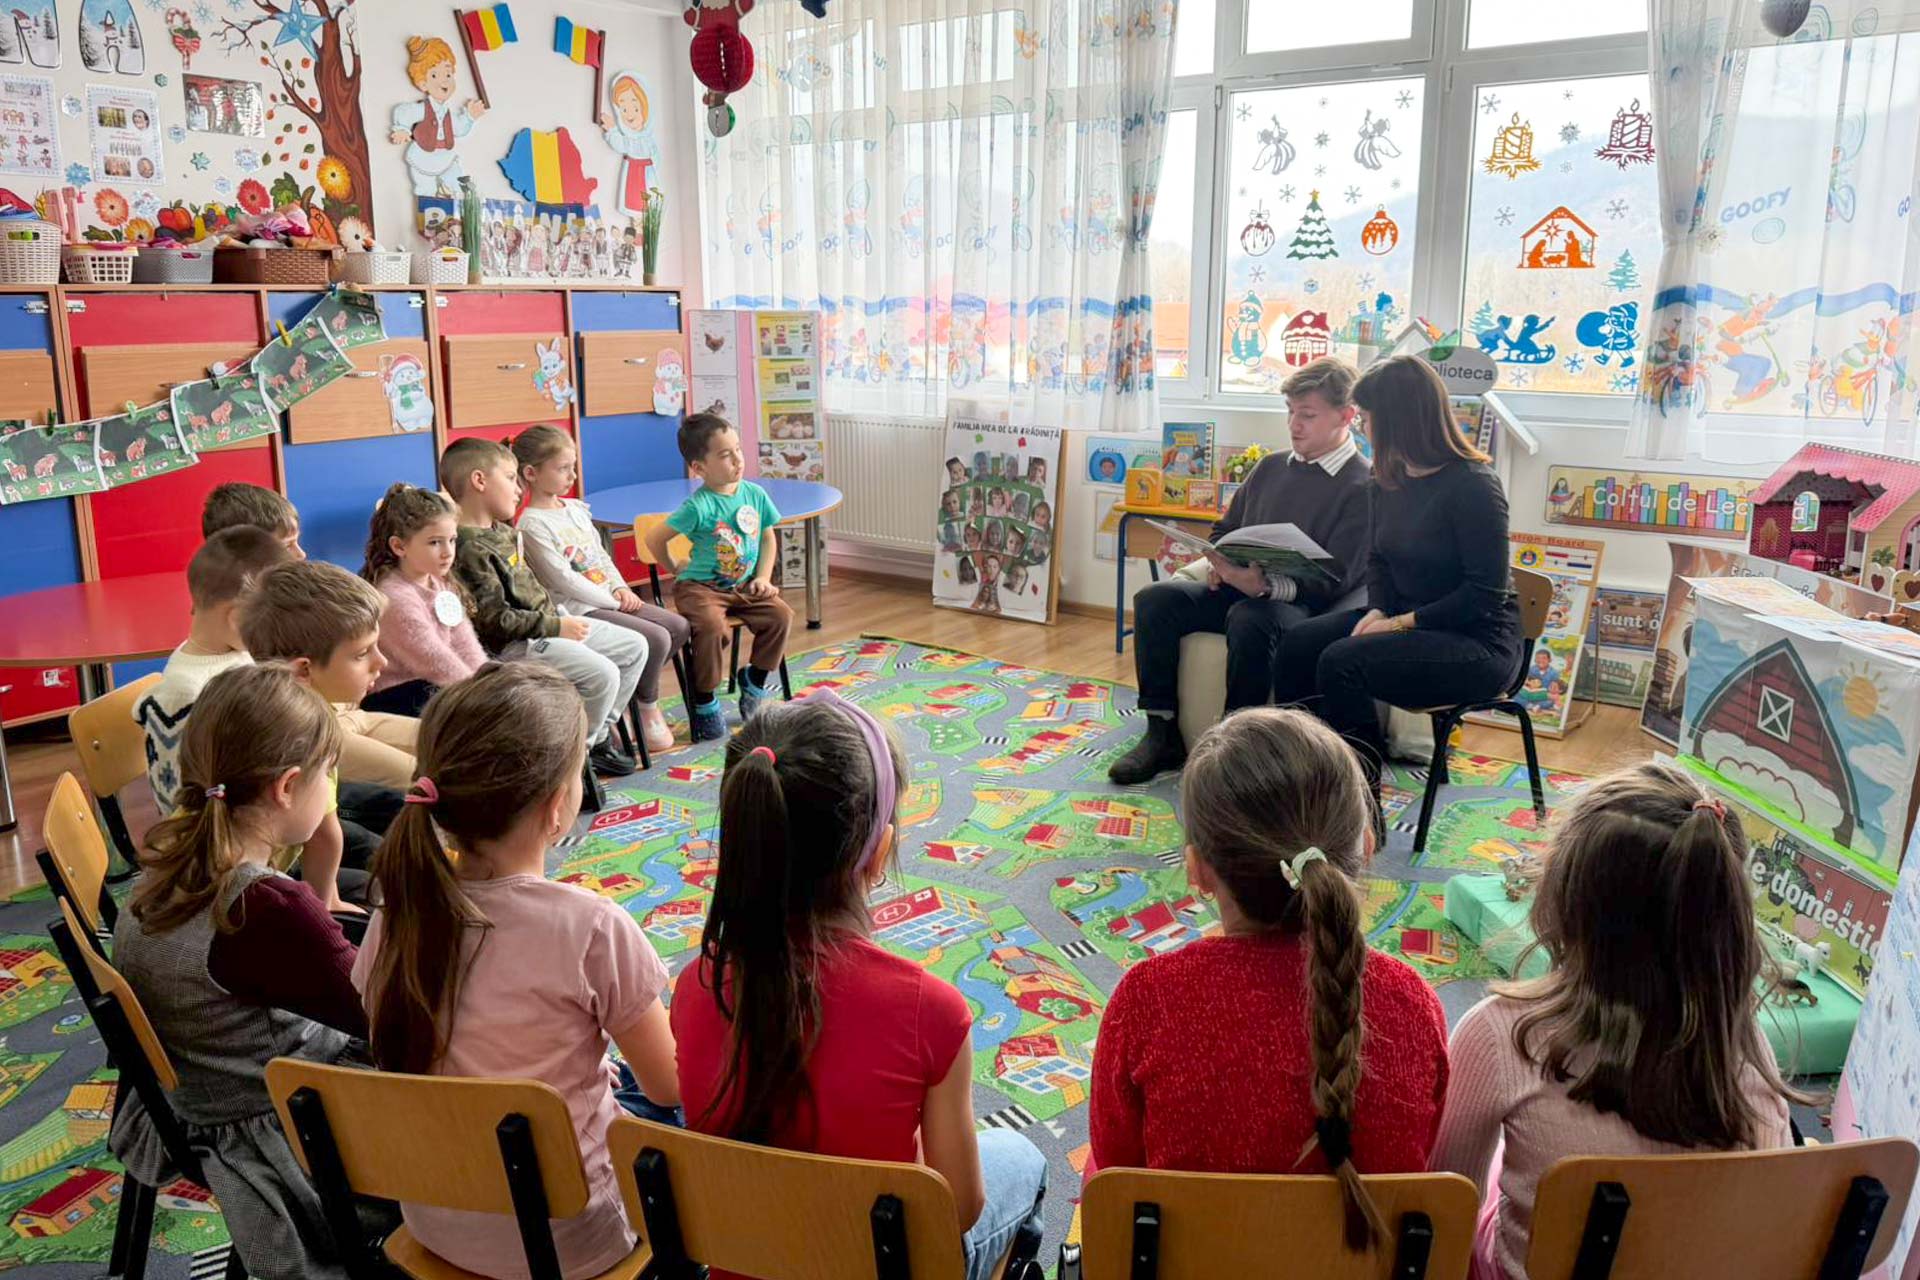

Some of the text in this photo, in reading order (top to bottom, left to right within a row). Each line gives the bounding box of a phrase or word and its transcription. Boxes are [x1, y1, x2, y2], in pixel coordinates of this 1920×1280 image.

[1720, 186, 1792, 223] GOOFY
[953, 421, 980, 431] FAMILIA
[981, 424, 996, 433] MEA
[998, 426, 1006, 434] DE
[1008, 426, 1018, 434] LA
[1593, 487, 1658, 513] Colțul
[1668, 492, 1697, 512] de
[1602, 614, 1643, 628] sunt
